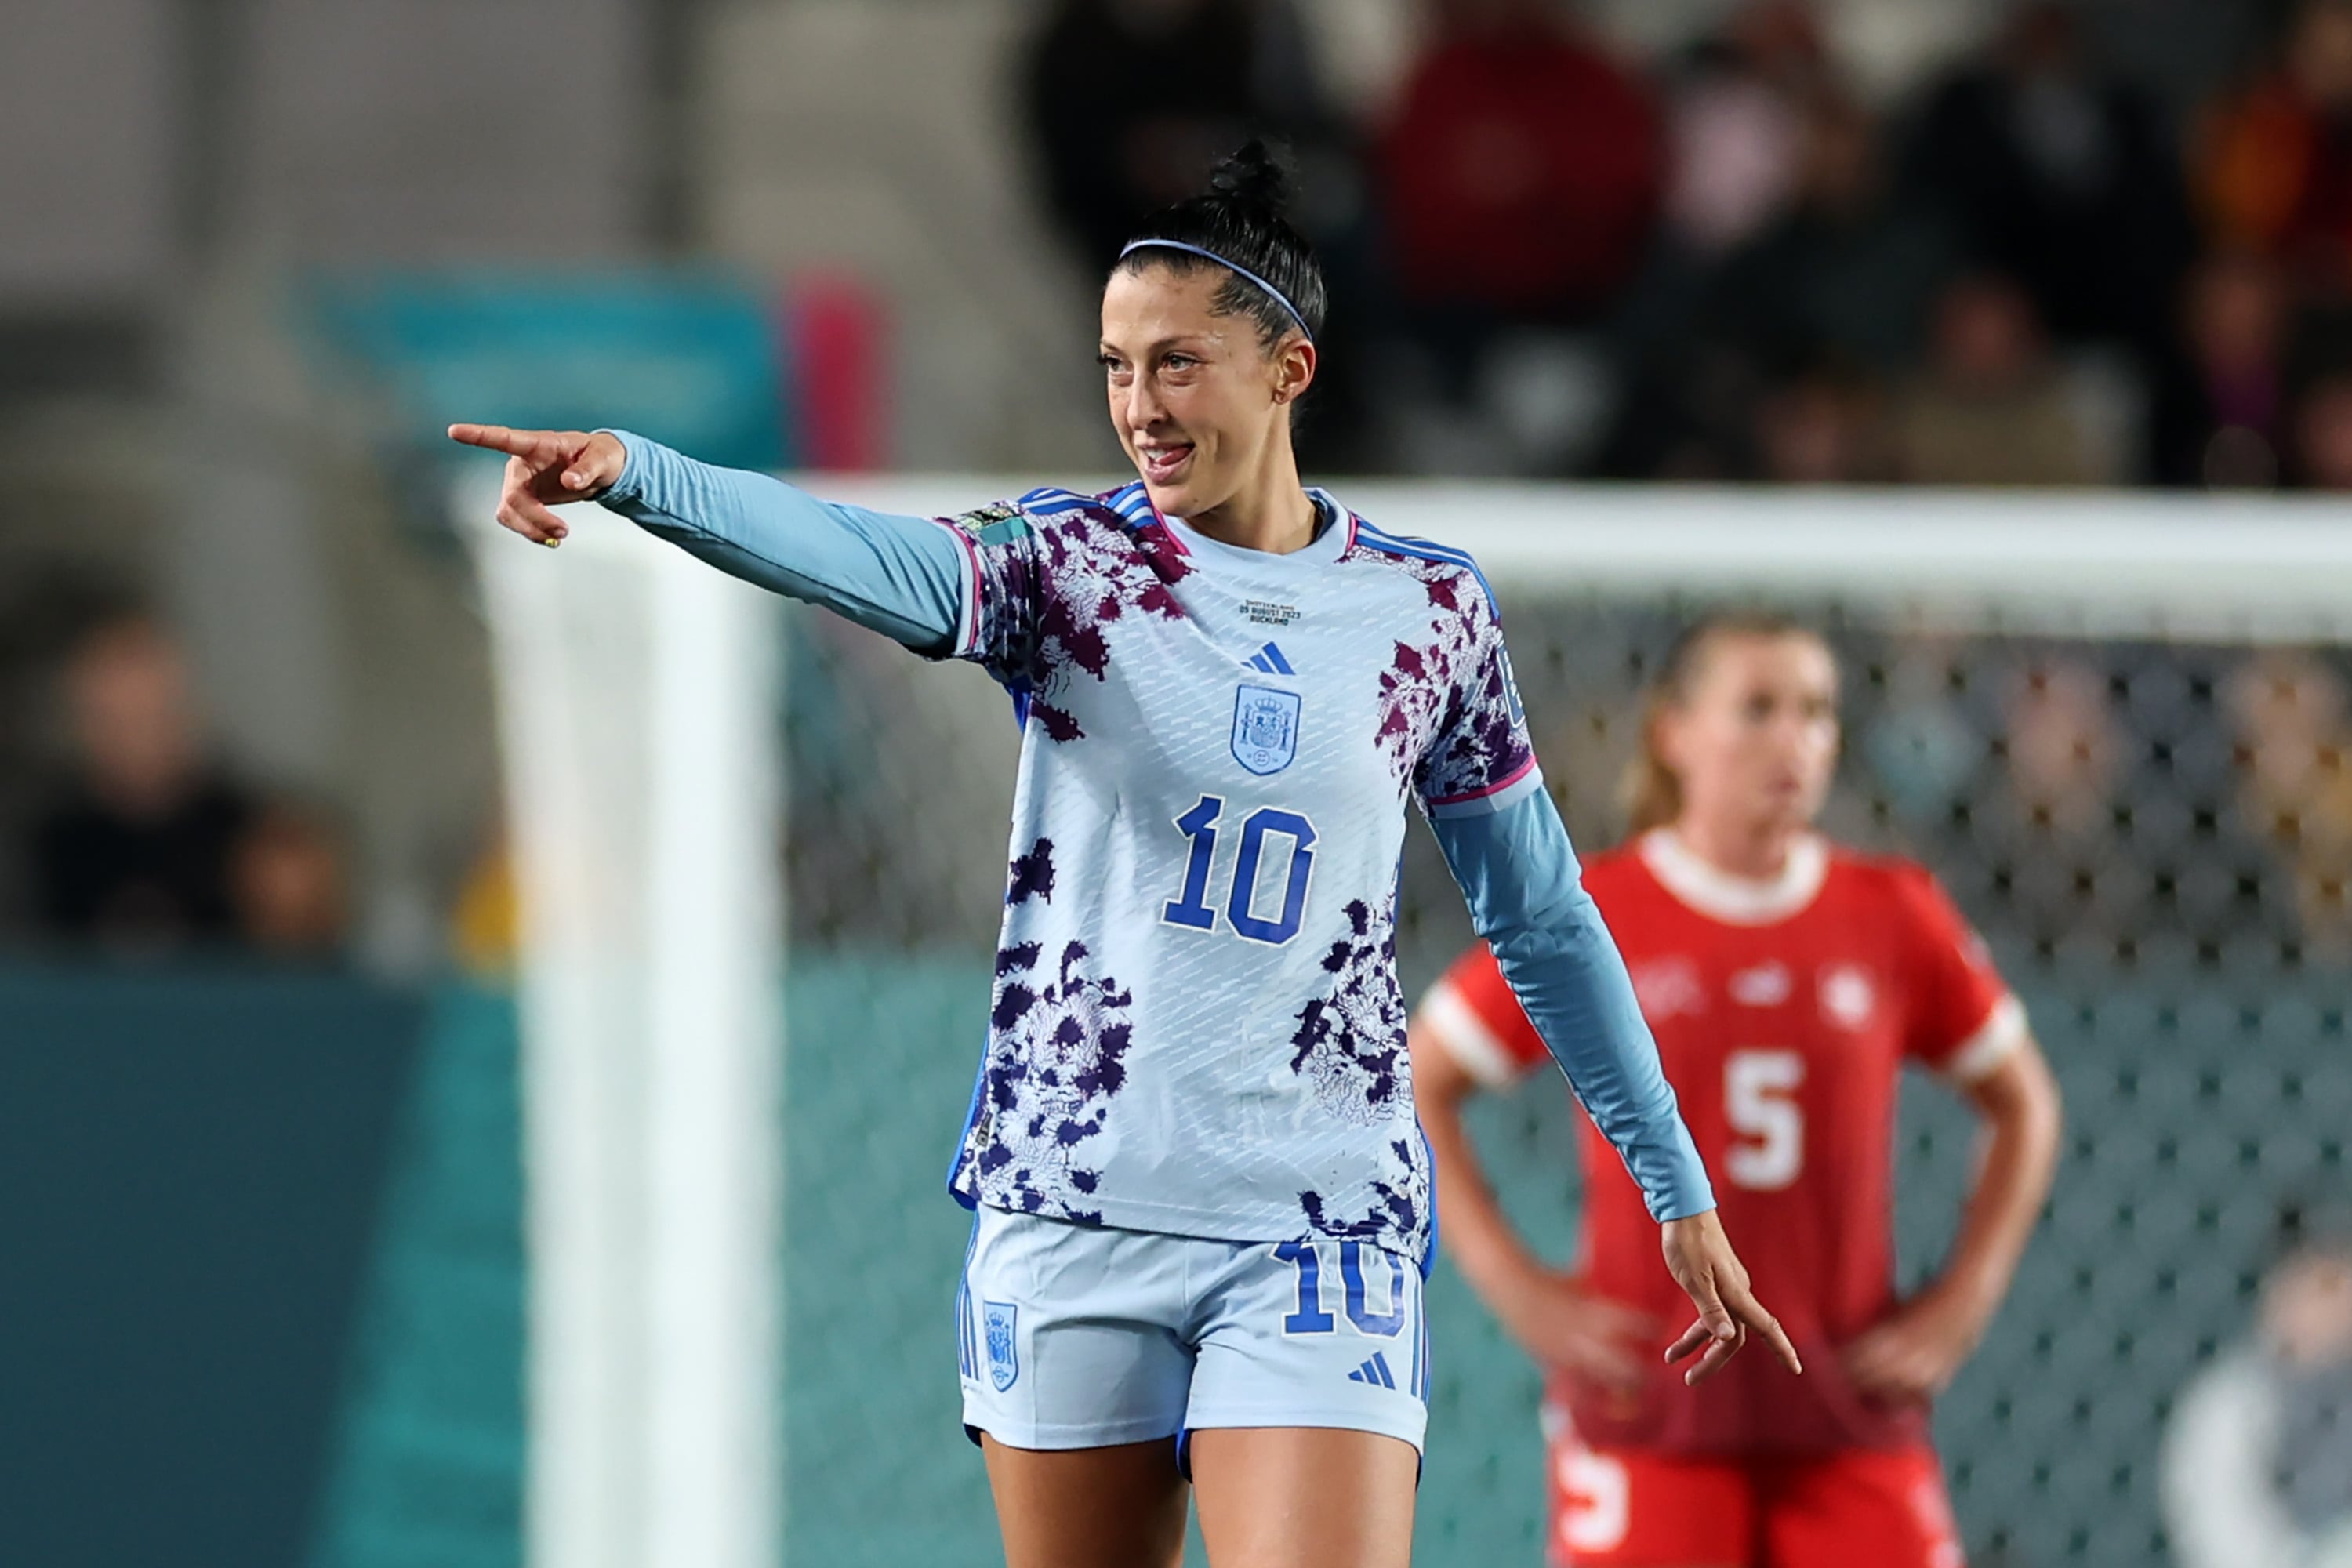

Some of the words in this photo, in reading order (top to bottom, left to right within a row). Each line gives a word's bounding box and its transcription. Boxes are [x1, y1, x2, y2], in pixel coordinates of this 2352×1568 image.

[1160, 793, 1319, 947] 10
[1725, 1049, 1806, 1190] 5
[1269, 1242, 1406, 1341] 10
